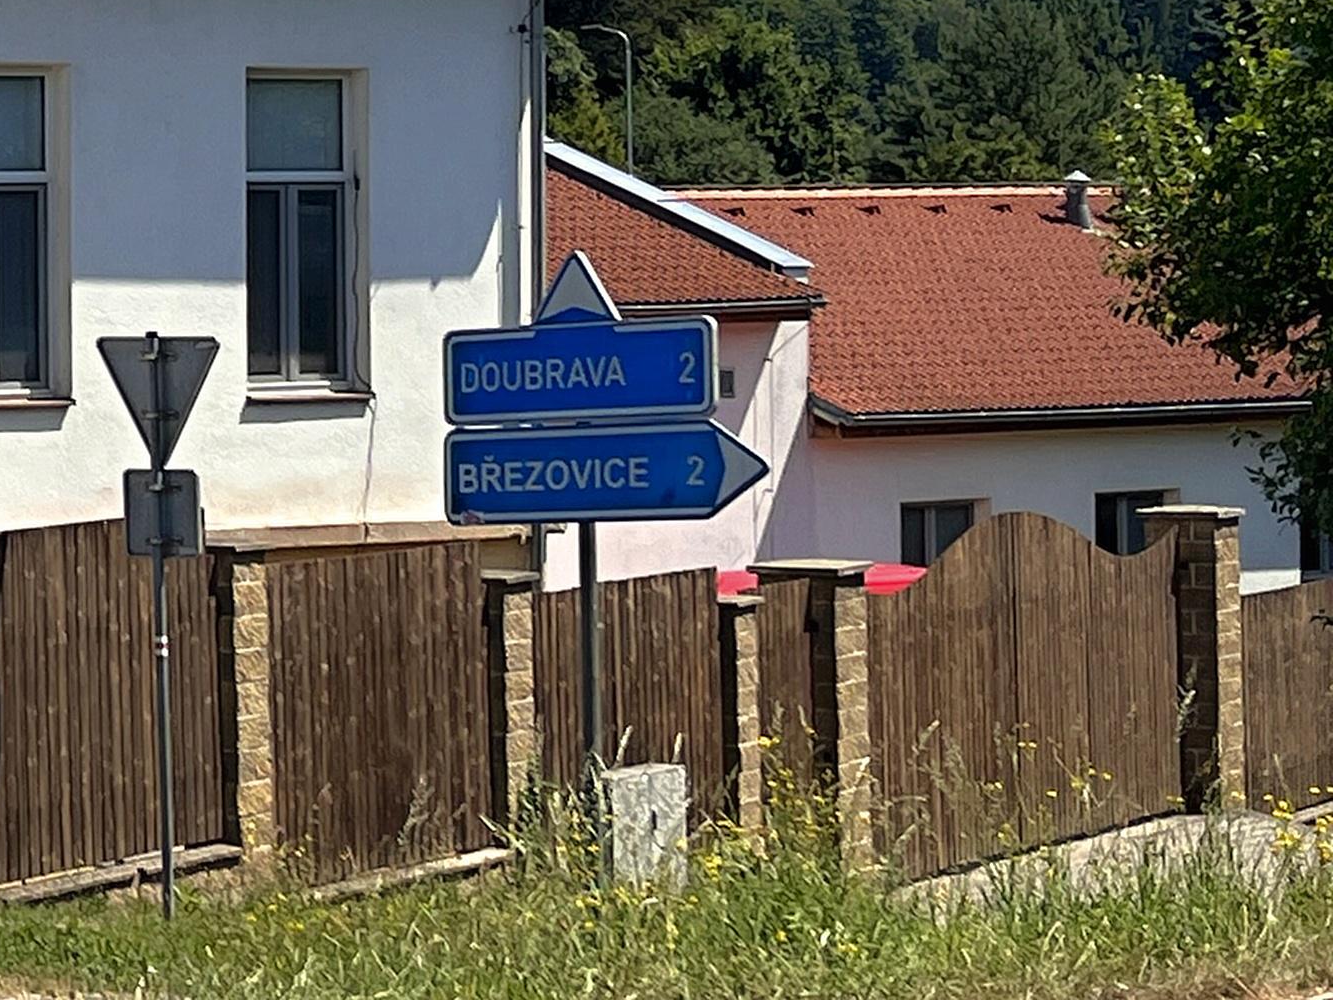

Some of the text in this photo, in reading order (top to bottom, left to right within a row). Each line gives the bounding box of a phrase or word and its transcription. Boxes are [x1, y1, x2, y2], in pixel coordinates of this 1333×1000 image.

[460, 351, 697, 394] DOUBRAVA 2
[458, 455, 705, 494] BŘEZOVICE 2
